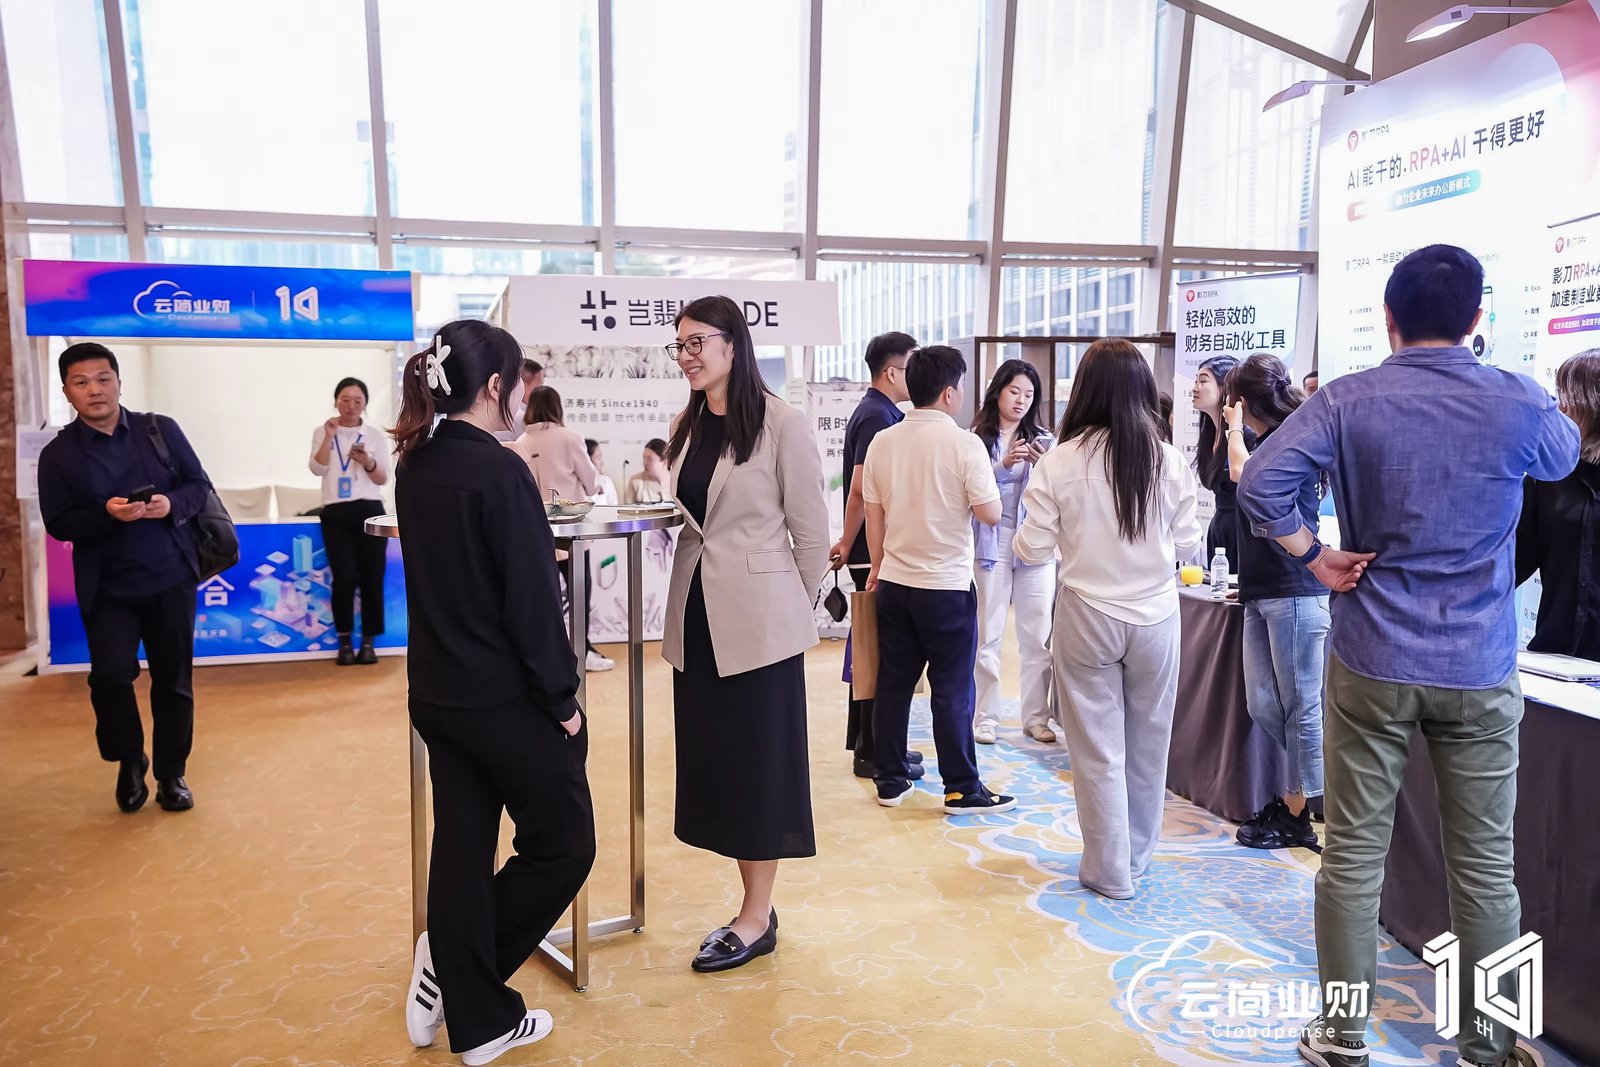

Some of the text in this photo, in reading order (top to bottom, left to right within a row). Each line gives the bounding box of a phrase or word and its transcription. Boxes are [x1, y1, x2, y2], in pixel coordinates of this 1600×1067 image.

[1473, 110, 1545, 154] 干得更好
[1396, 176, 1471, 205] 力企业未来办公新模式
[154, 299, 231, 314] 云简业财
[1186, 305, 1256, 329] 轻松高效的
[1185, 329, 1286, 353] 财务自动化工具
[601, 399, 659, 408] Since1940
[818, 416, 848, 431] 限时
